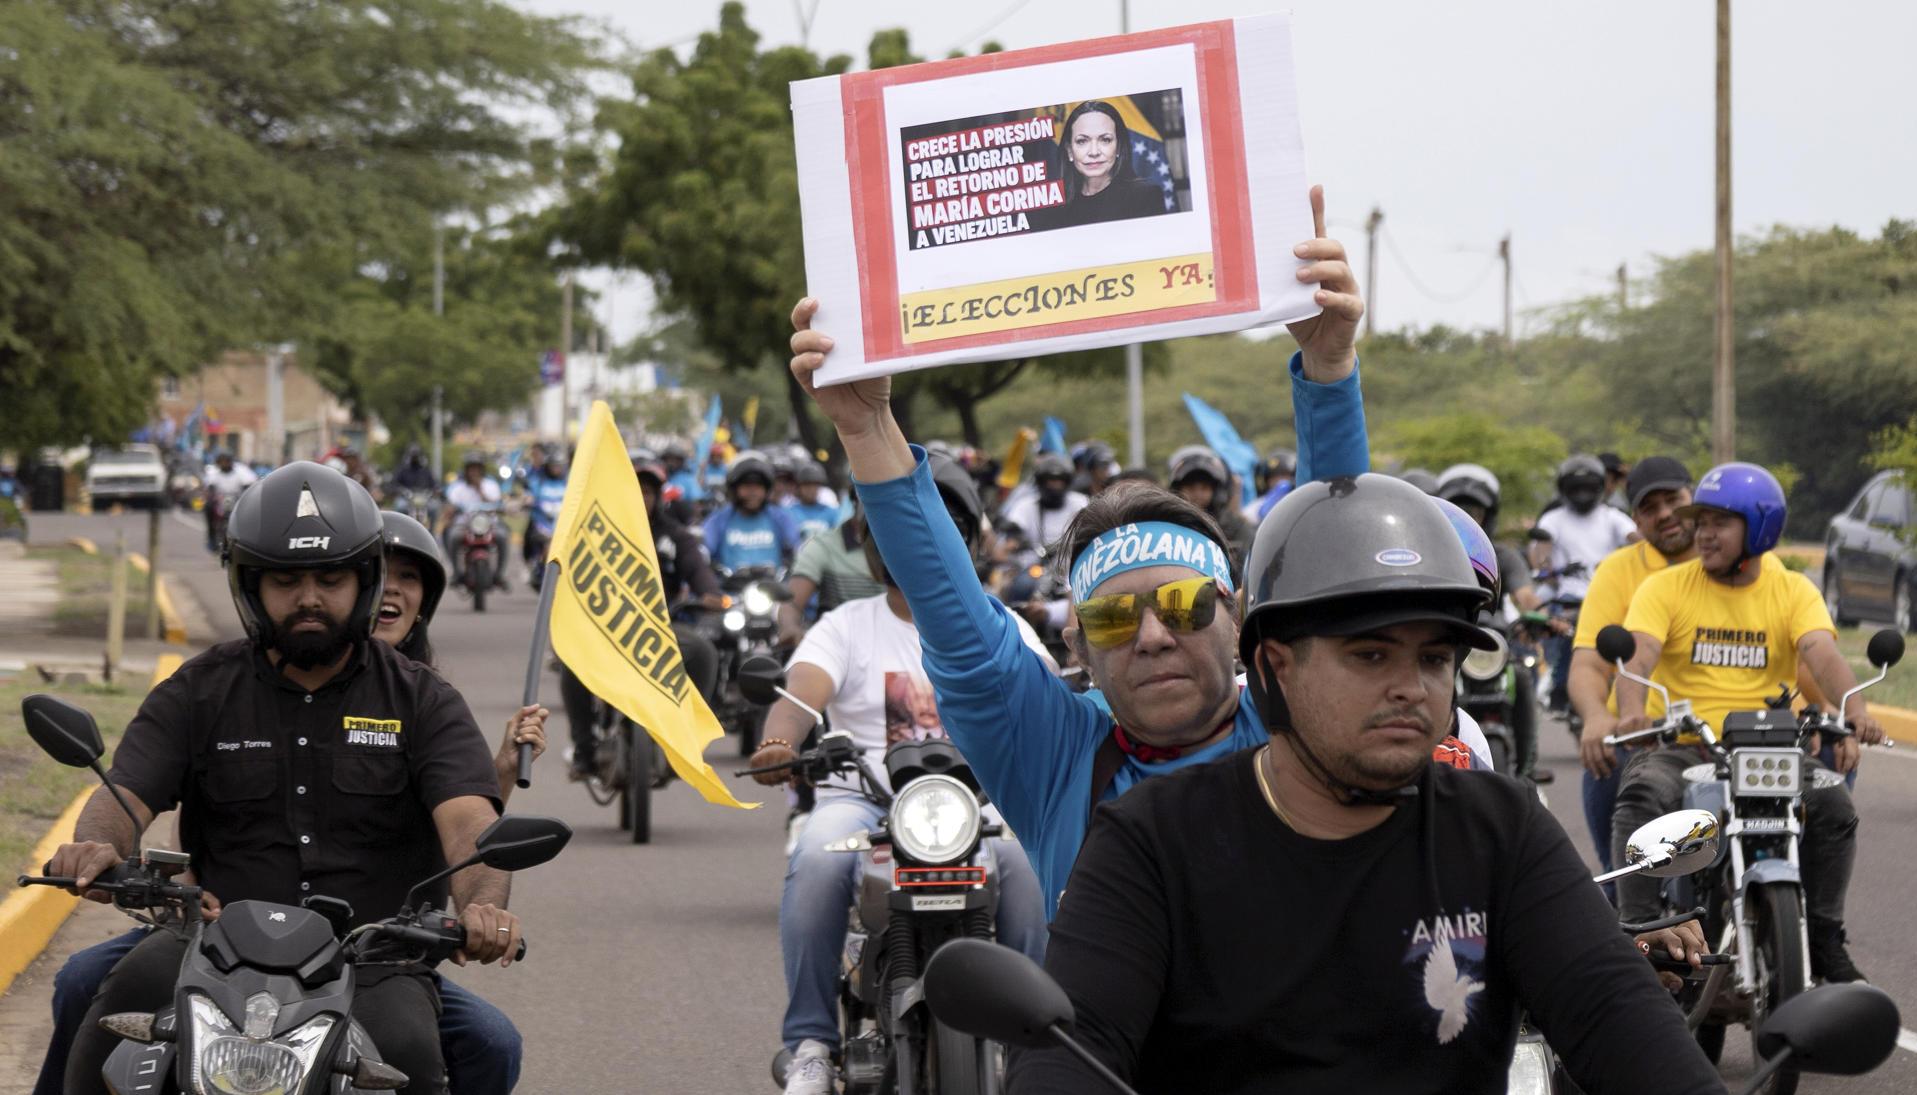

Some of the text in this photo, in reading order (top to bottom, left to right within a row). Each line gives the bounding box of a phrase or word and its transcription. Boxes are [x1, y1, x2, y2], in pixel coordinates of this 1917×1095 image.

[907, 117, 1054, 160] CRECE LA PRESIÓN
[910, 145, 1025, 181] PARA LOGRAR
[911, 162, 1046, 202] EL RETORNO DE
[913, 182, 1064, 228] MARÍA CORINA
[916, 213, 1030, 249] A VENEZUELA
[1115, 523, 1139, 537] LA
[1696, 627, 1767, 643] PRIMERO
[1692, 641, 1766, 668] JUSTICIA
[346, 729, 397, 746] JUSTICIA
[348, 720, 397, 731] PRIMERO
[217, 741, 272, 751] Diego Torres
